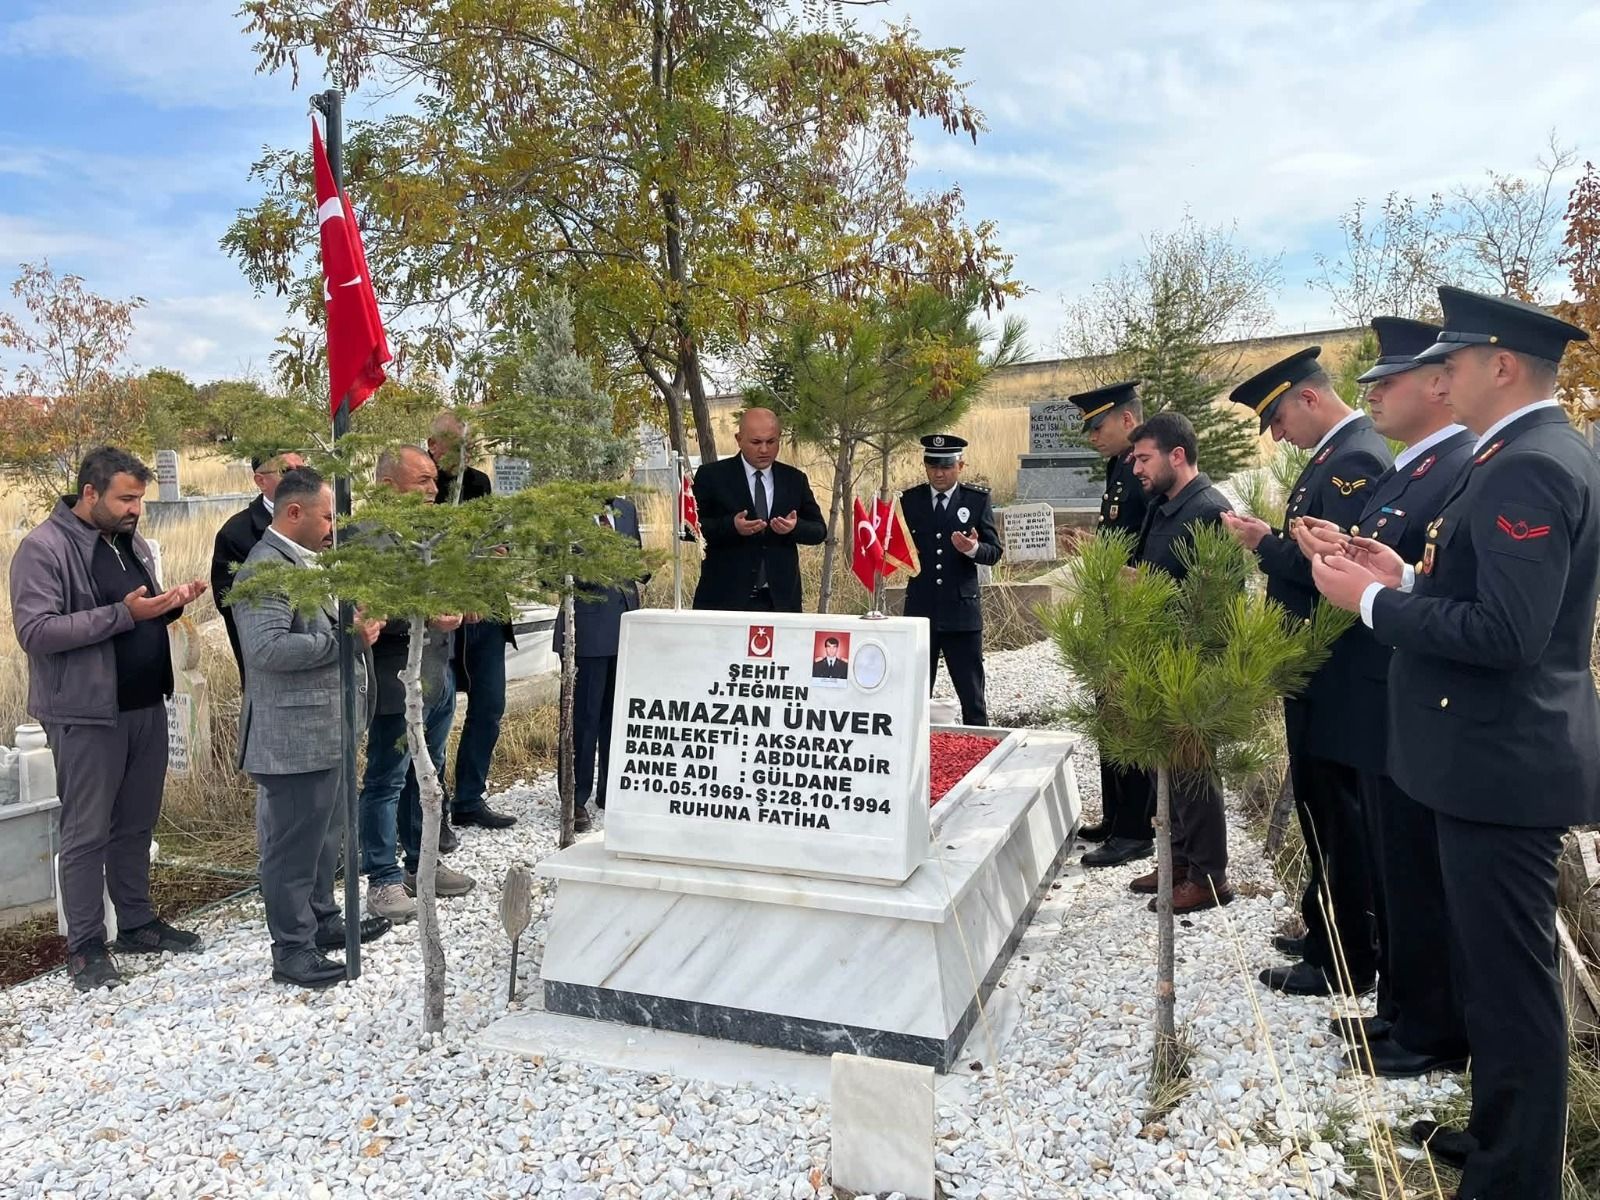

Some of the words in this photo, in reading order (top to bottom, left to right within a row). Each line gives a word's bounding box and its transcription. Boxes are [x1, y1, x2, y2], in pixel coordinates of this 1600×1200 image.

[729, 662, 790, 684] ŞEHİT
[708, 680, 808, 701] J.TEĞMEN
[629, 698, 770, 728] RAMAZAN
[784, 702, 892, 737] ÜNVER
[625, 739, 674, 758] BABA
[681, 744, 714, 760] ADI
[754, 749, 889, 775] ABDULKADİR
[755, 733, 853, 754] AKSARAY
[624, 759, 676, 777] ANNE
[683, 763, 718, 781] ADI
[753, 766, 851, 793] GÜLDANE
[669, 799, 750, 822] RUHUNA
[758, 807, 829, 830] FATİHA
